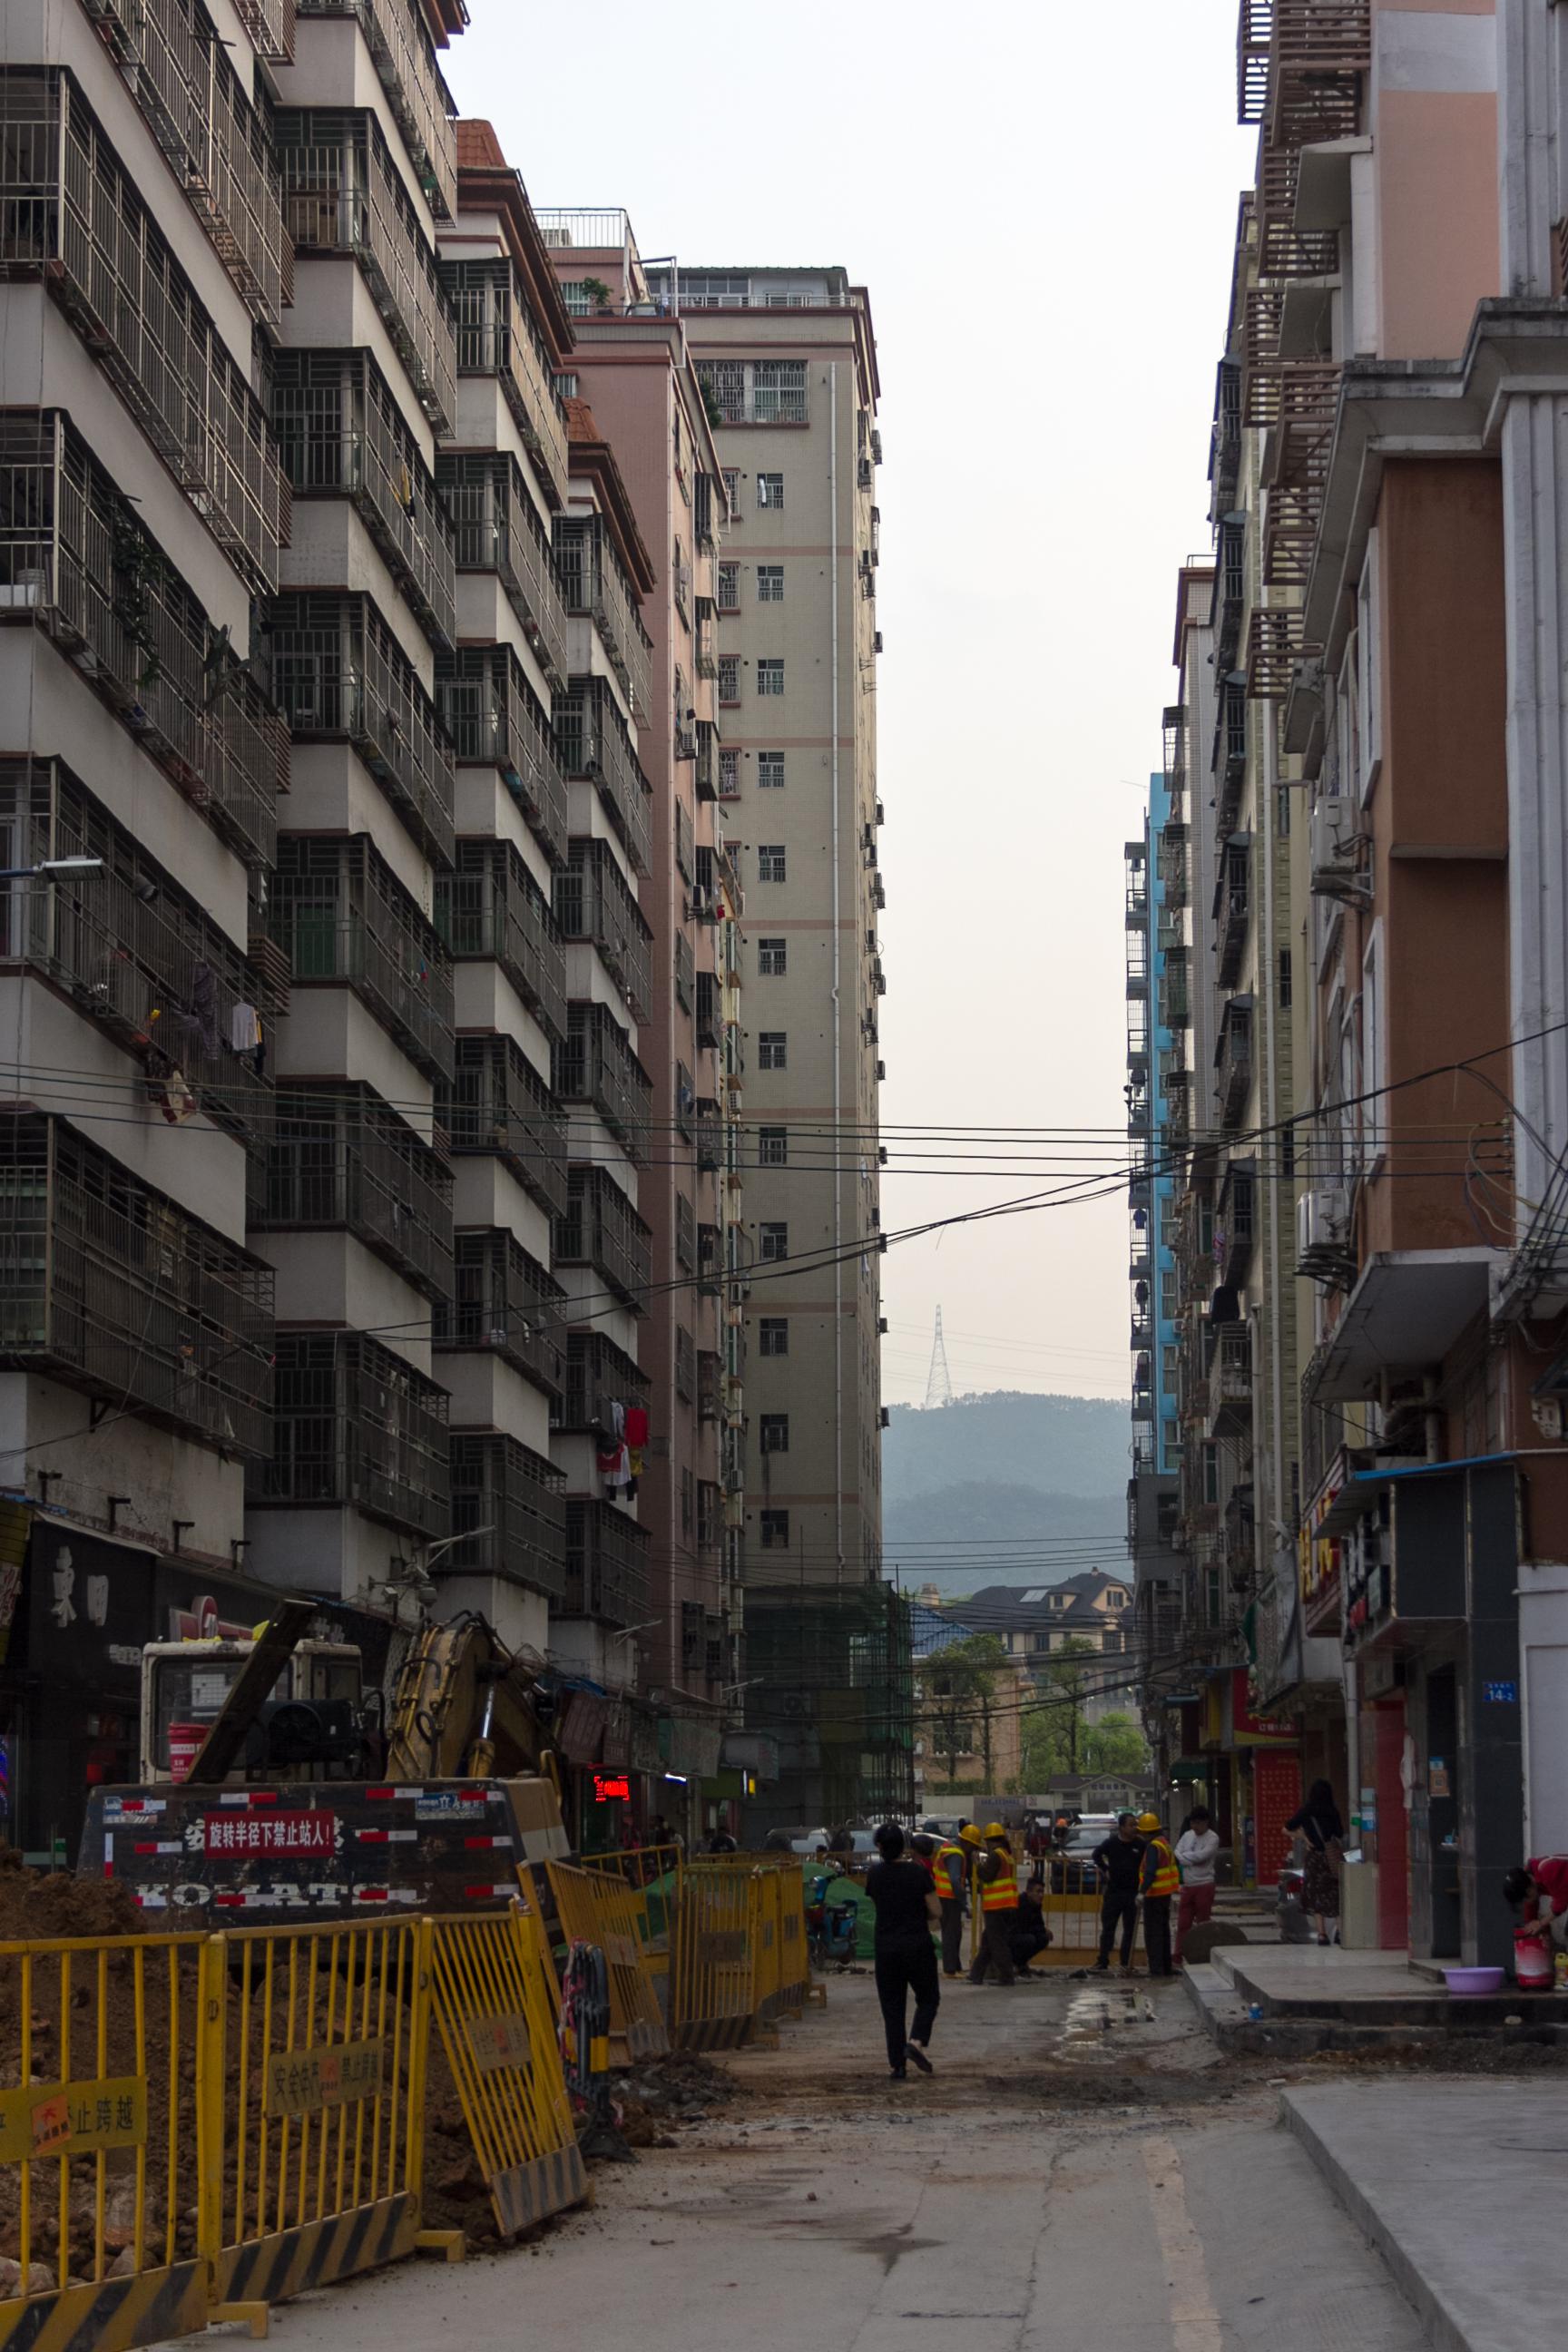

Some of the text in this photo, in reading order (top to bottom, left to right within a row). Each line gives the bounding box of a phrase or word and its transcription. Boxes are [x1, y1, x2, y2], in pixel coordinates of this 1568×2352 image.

[209, 1819, 330, 1848] 旋转半径下禁止站人!
[134, 1882, 433, 1907] KOMATS
[67, 2094, 134, 2135] 止跨越
